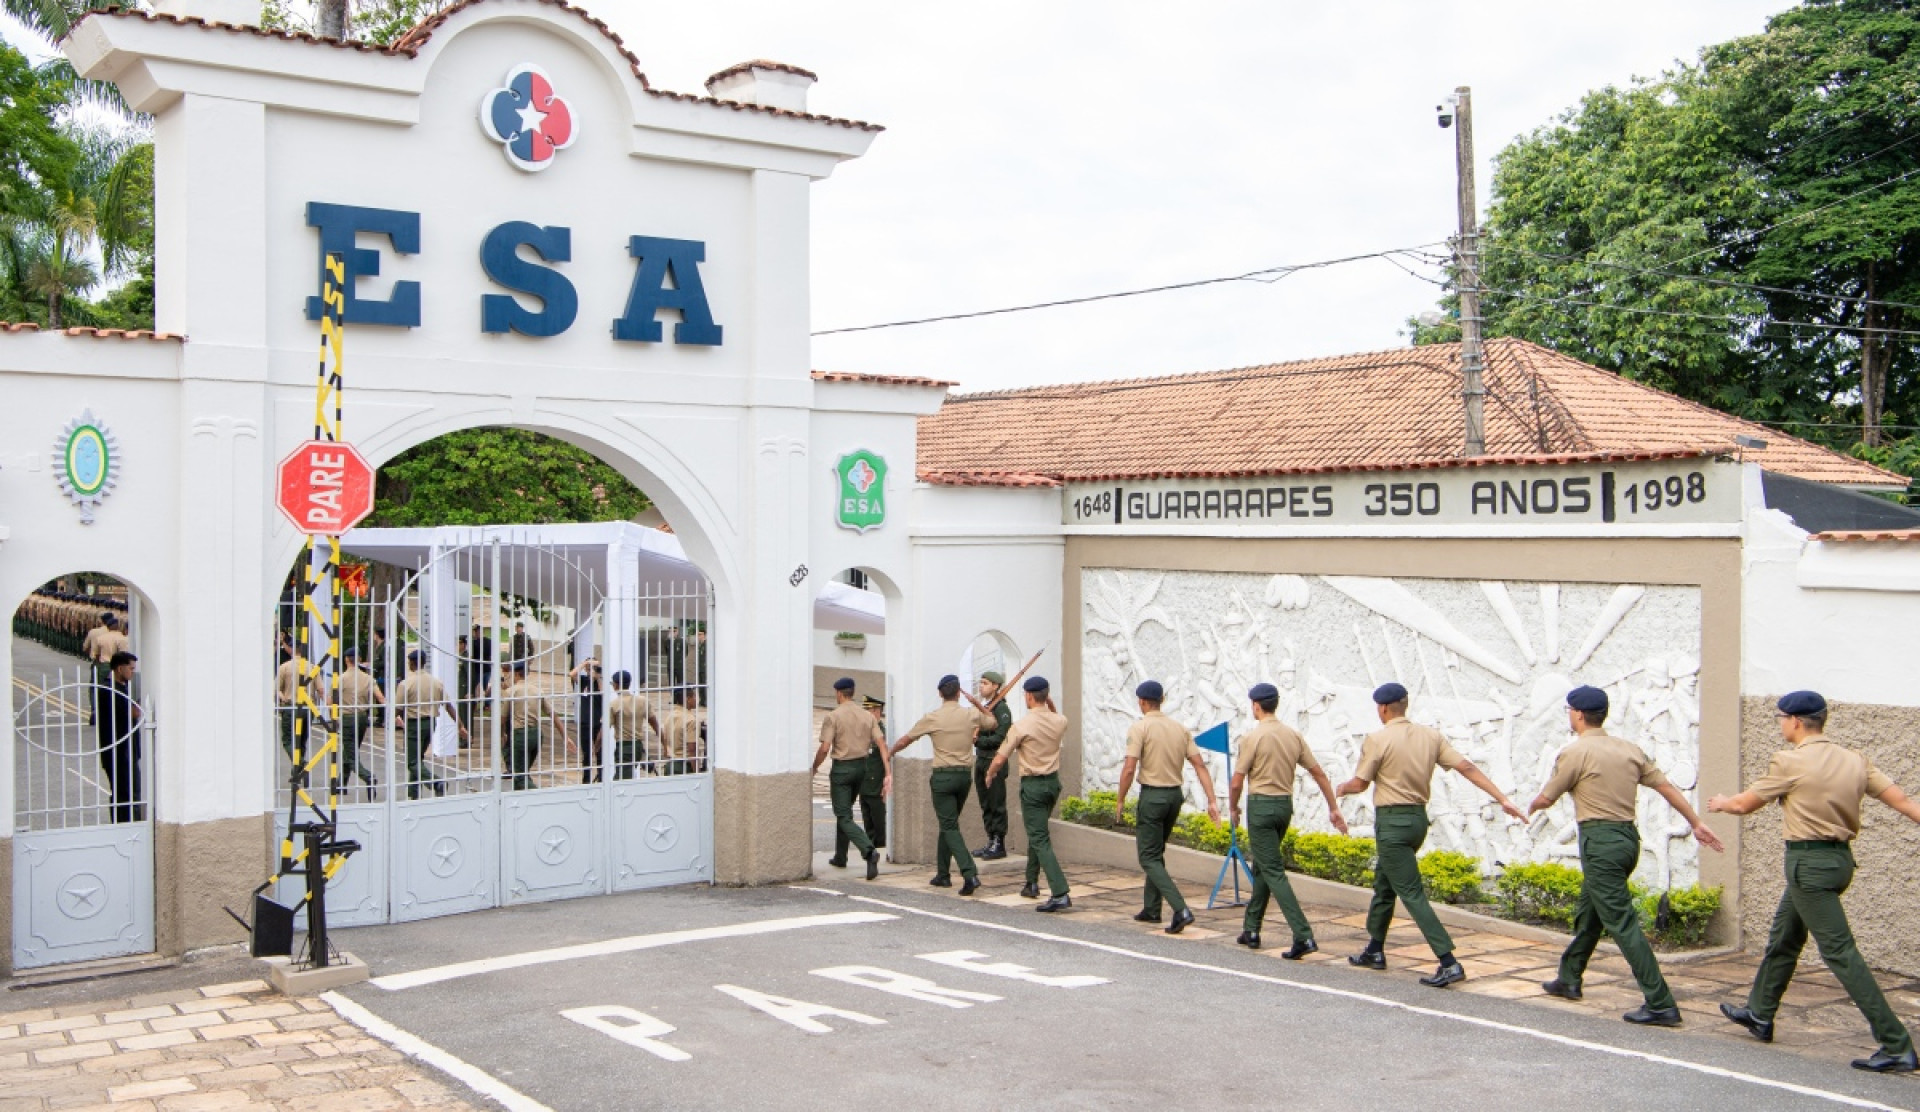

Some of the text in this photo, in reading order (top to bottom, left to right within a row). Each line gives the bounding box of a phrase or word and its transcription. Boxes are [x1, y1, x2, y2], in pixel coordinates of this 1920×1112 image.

[305, 201, 723, 346] ESA
[307, 451, 345, 525] PARE
[844, 498, 882, 514] ESA
[1073, 471, 1706, 520] 1648 GUARARAPES 350 ANOS 1998
[558, 949, 1112, 1062] PARE
